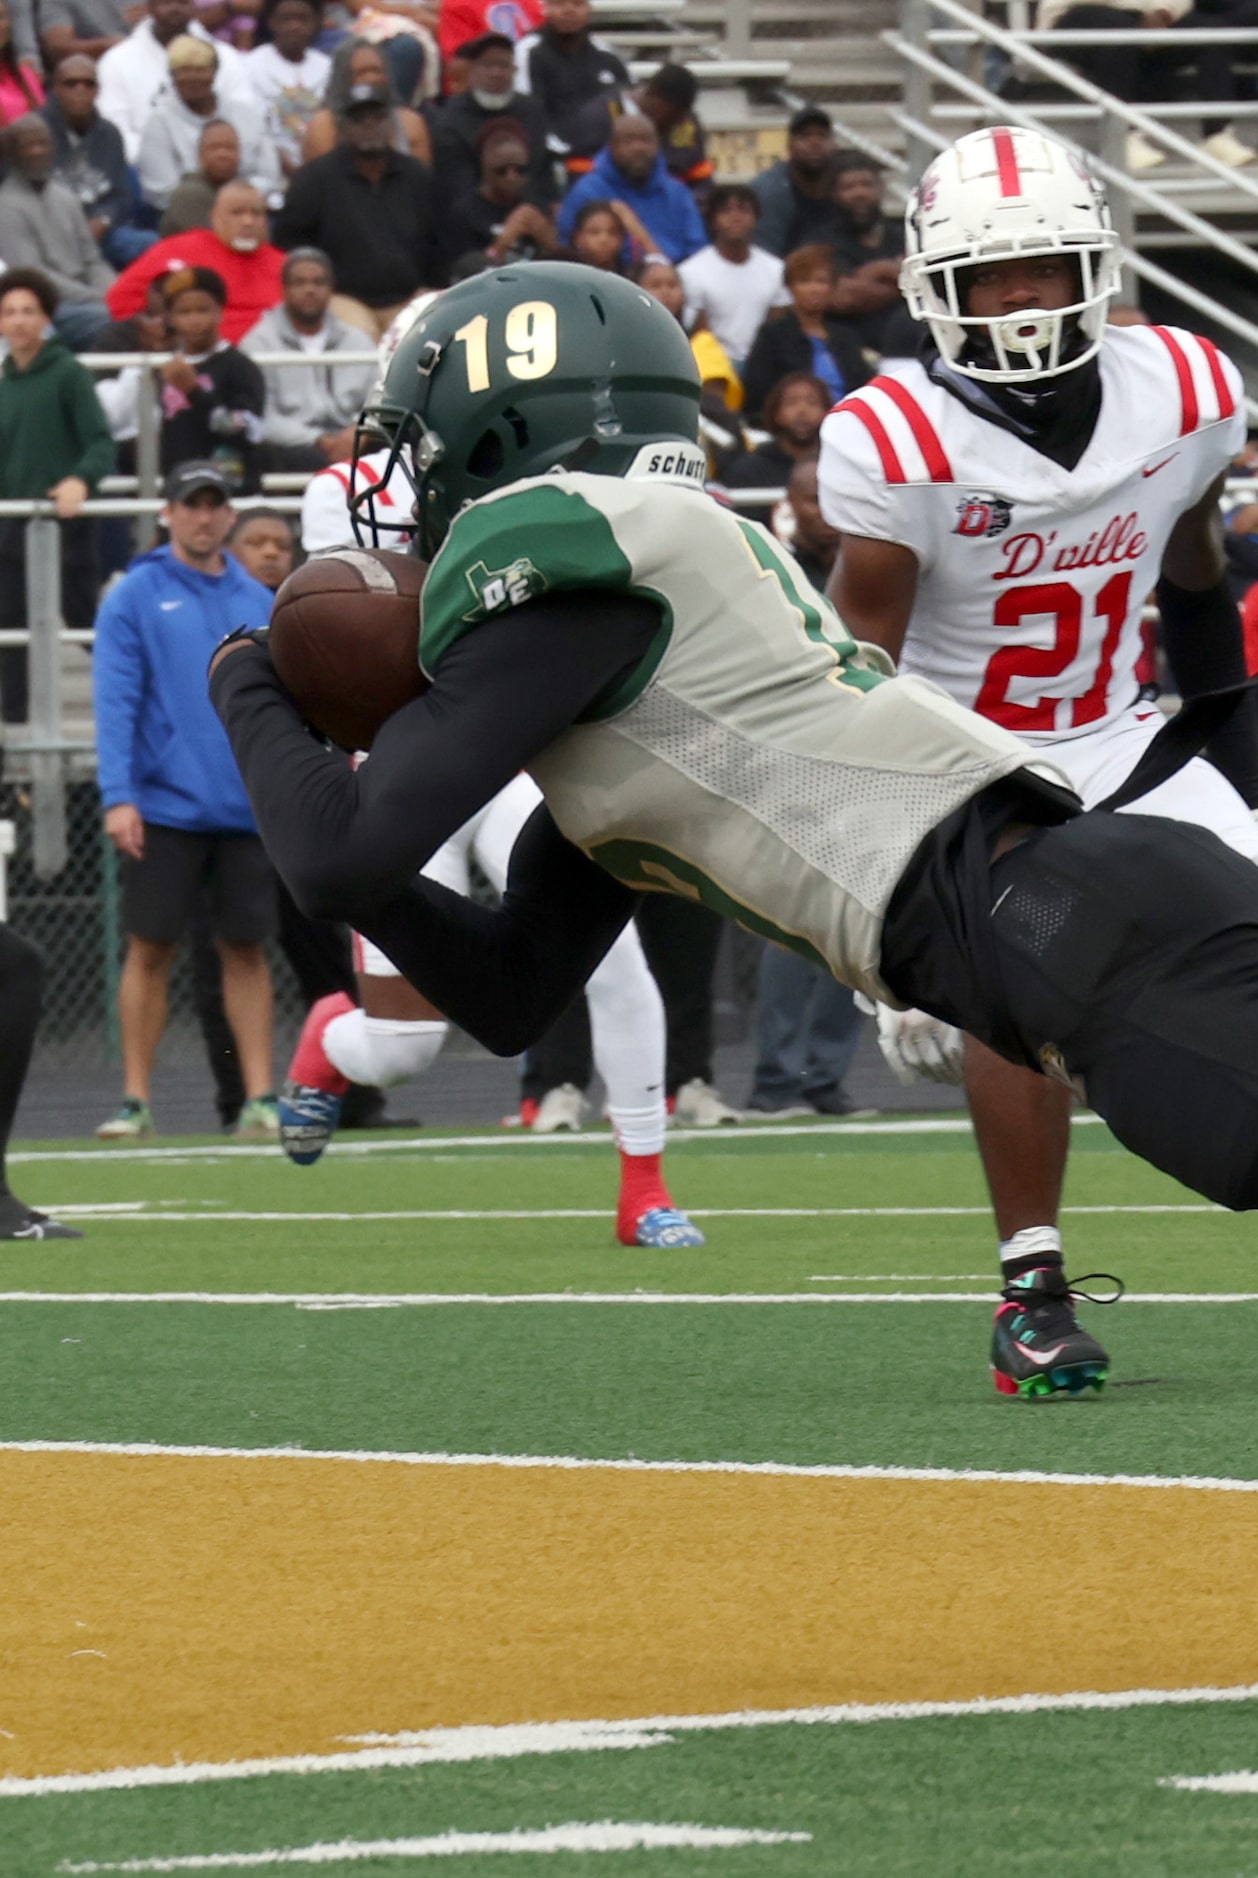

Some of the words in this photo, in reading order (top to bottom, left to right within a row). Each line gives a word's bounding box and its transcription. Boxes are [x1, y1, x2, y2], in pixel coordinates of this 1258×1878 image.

[454, 300, 558, 394] 19
[991, 511, 1148, 581] D'ville
[973, 570, 1135, 732] 21
